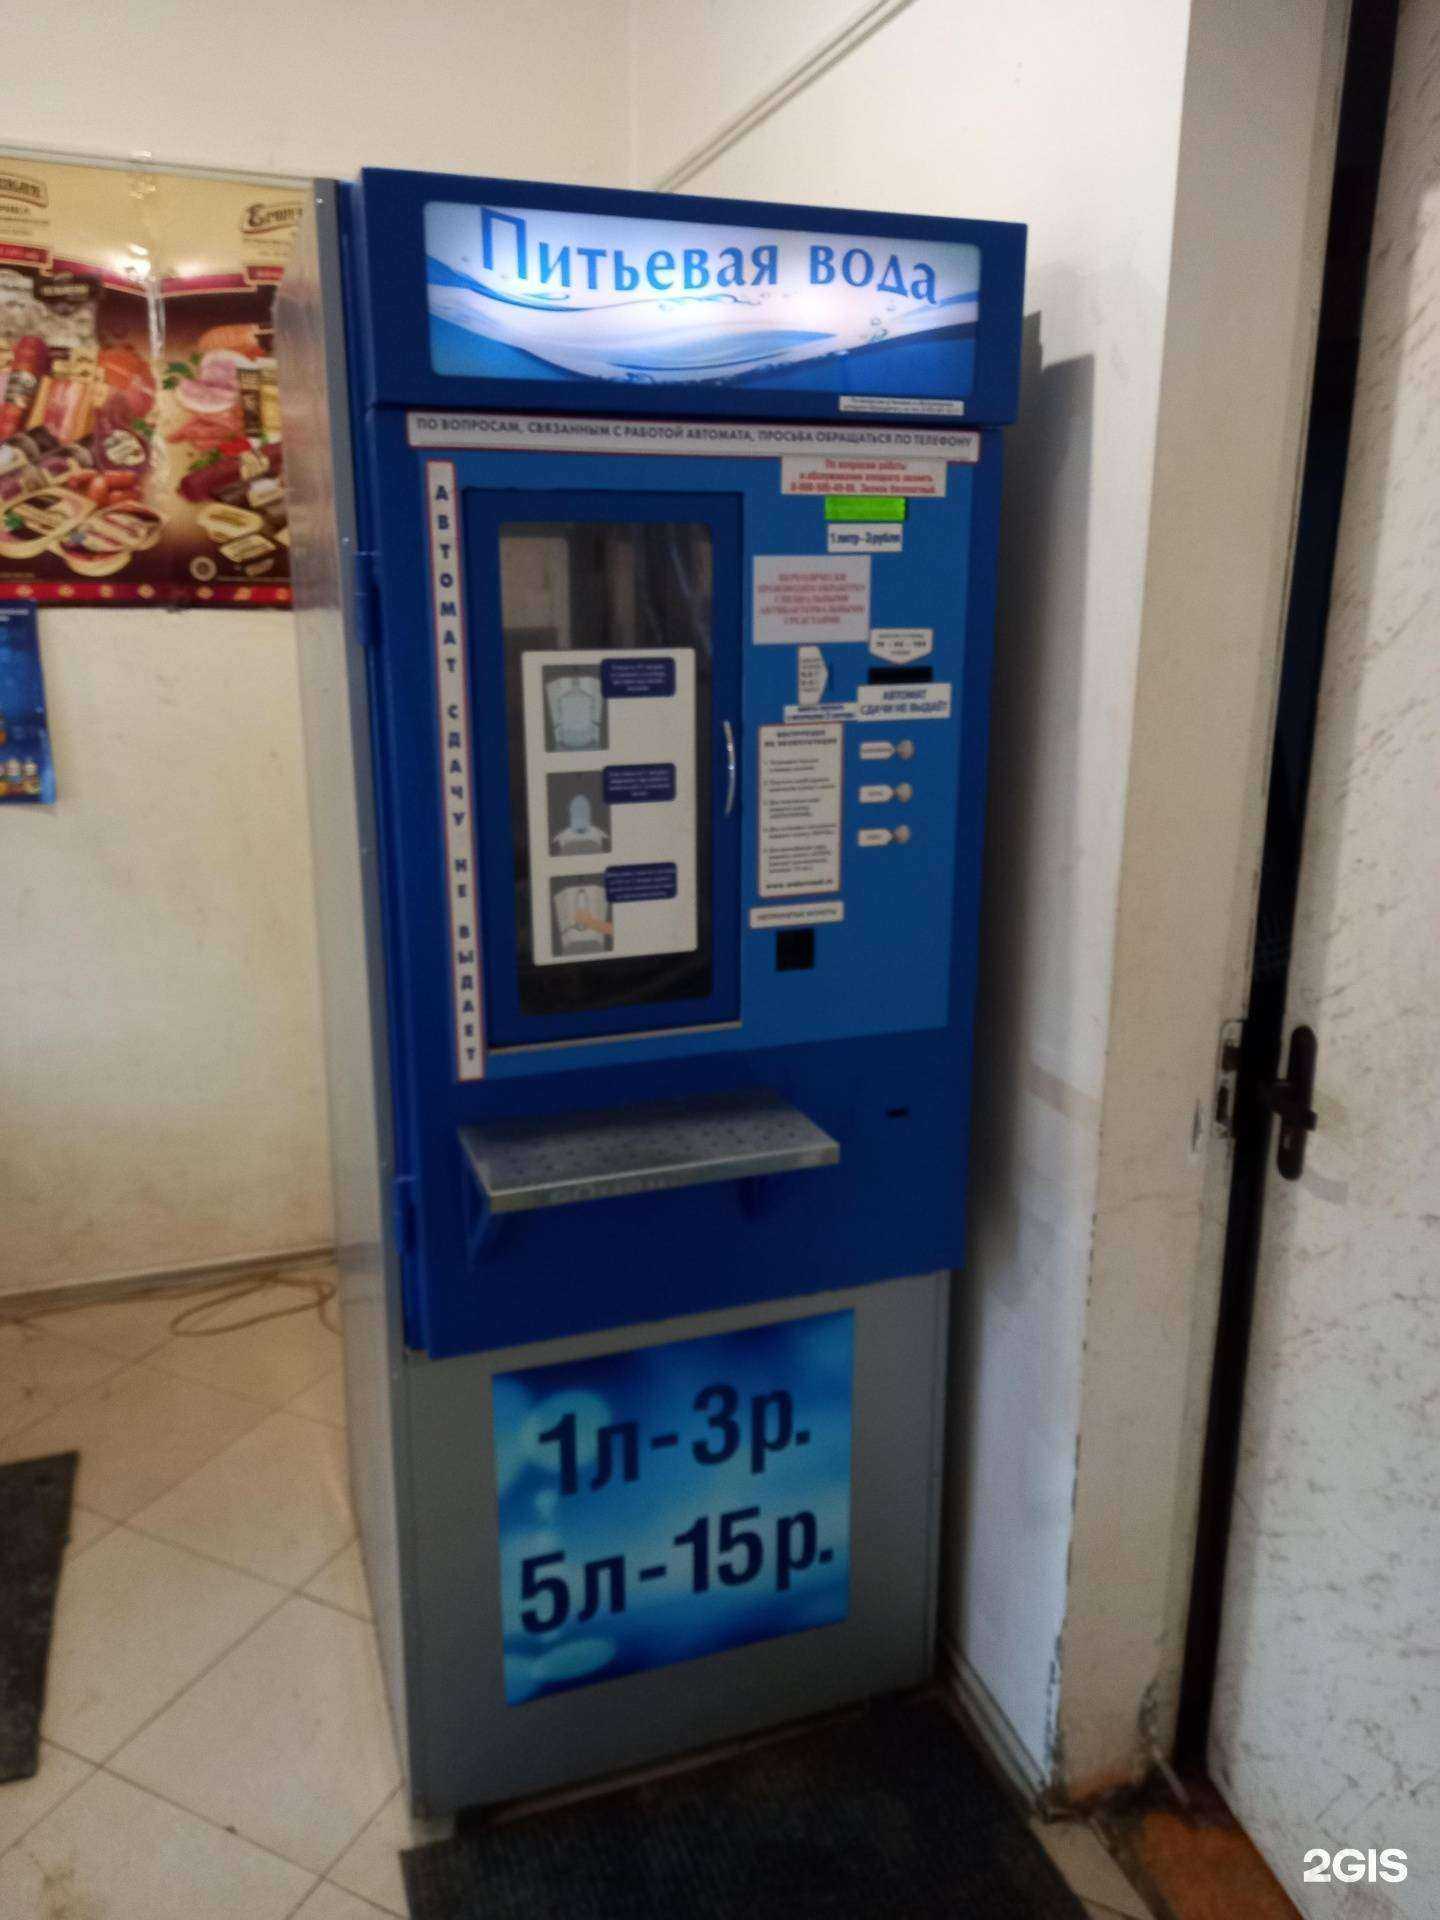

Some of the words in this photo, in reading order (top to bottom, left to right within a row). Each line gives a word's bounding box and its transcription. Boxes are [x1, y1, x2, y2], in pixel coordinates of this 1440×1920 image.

[480, 207, 779, 292] Питьевая
[809, 244, 938, 304] вода
[417, 418, 438, 430] ПО
[613, 425, 622, 437] С
[625, 425, 684, 439] РАБОТОЙ
[758, 429, 813, 442] ПРОСЬБА
[816, 431, 892, 445] ОБРАЩАТЬСЯ
[895, 434, 912, 445] ПО
[915, 434, 972, 447] ТЕЛЕФОНУ
[436, 485, 457, 673] АВТОМАТ
[447, 704, 466, 827] СДАЧУ
[455, 858, 468, 898] НЕ
